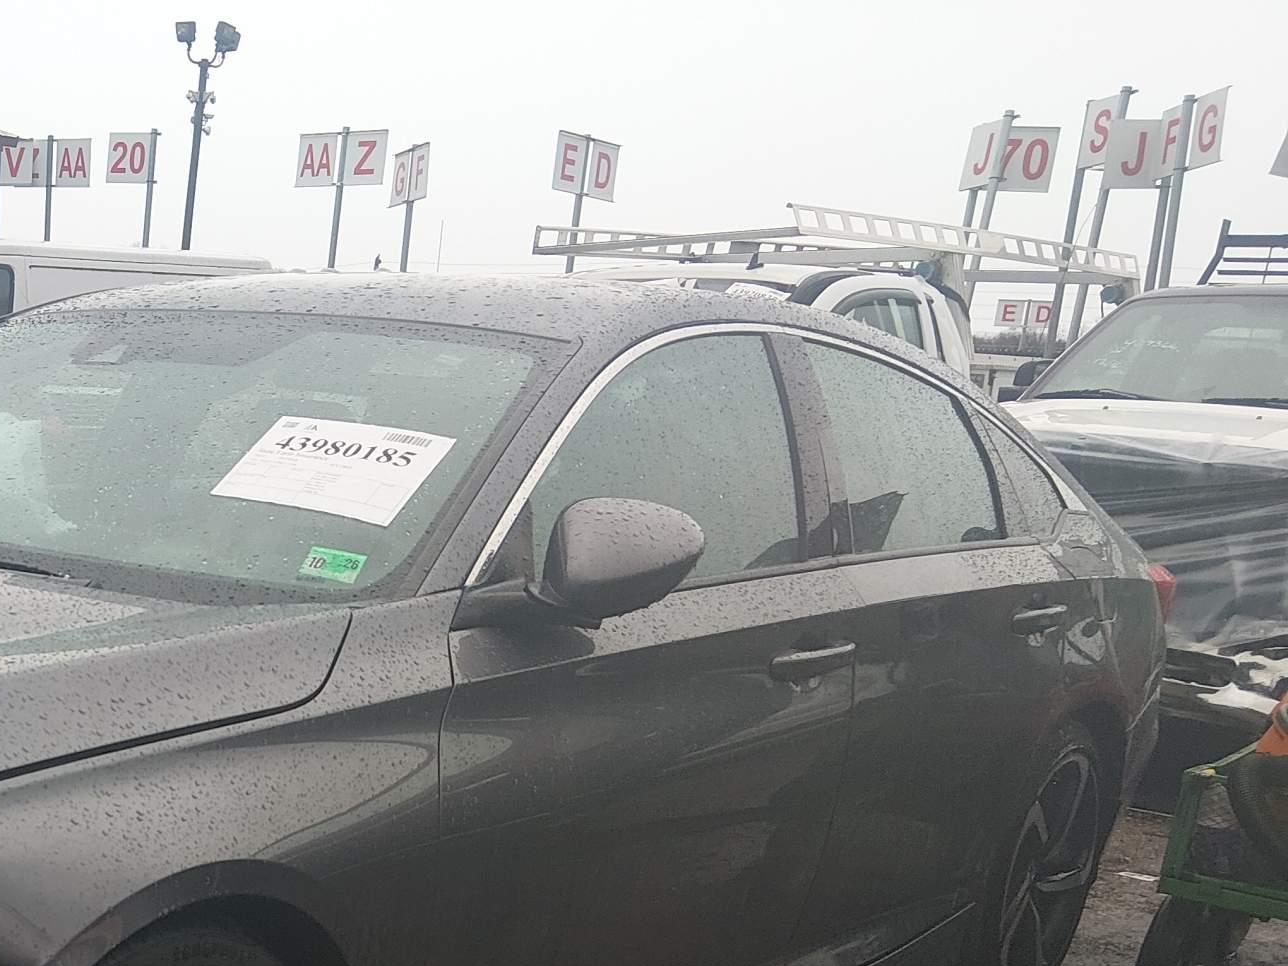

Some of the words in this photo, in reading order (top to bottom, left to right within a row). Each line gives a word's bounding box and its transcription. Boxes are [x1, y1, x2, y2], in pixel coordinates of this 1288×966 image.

[1090, 110, 1112, 154] S
[1163, 119, 1180, 165] F
[1199, 105, 1219, 153] G
[6, 148, 25, 177] V
[60, 148, 87, 178] AA
[111, 142, 146, 174] 20
[300, 143, 332, 178] AA
[354, 141, 377, 176] Z
[561, 145, 579, 182] E
[595, 152, 612, 189] D
[974, 133, 995, 176] J
[1122, 133, 1148, 176] J
[395, 162, 406, 197] G
[416, 155, 425, 191] F
[1002, 305, 1017, 322] E
[1036, 306, 1052, 323] D
[274, 435, 417, 467] 43980185
[308, 556, 326, 569] 10
